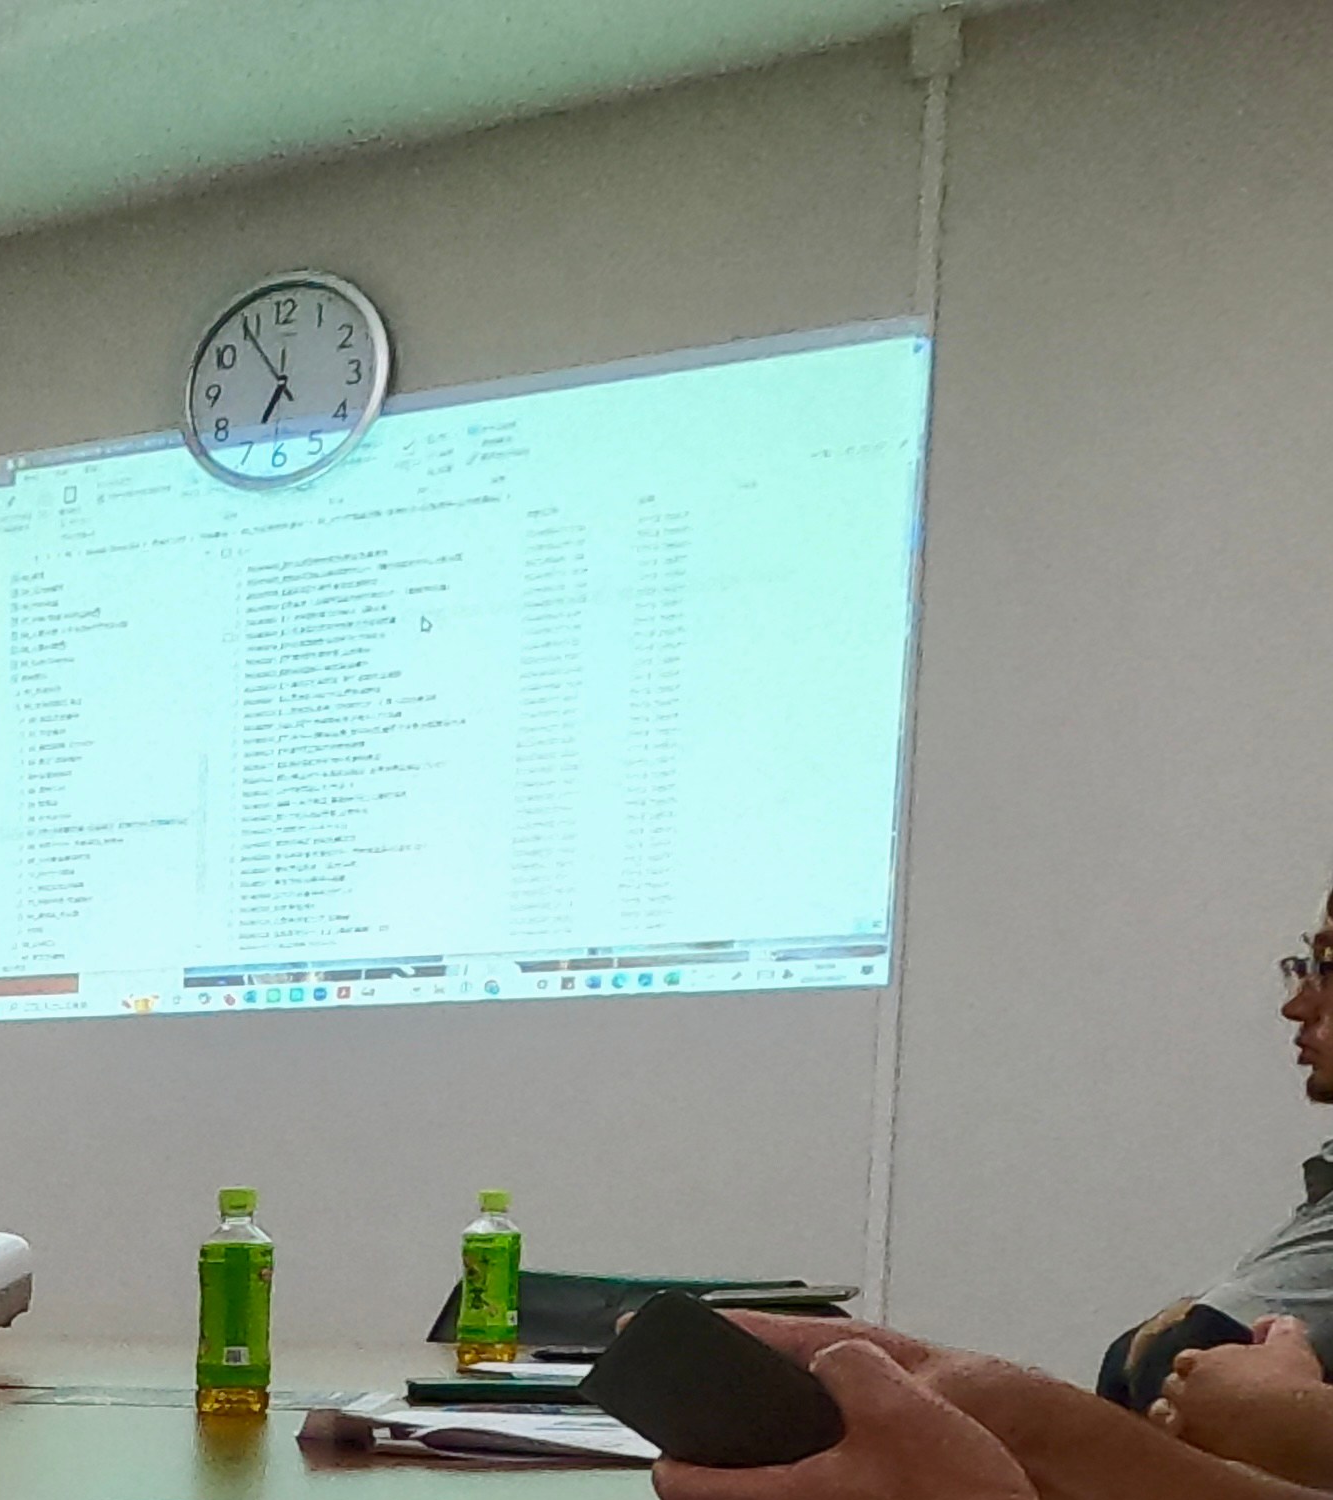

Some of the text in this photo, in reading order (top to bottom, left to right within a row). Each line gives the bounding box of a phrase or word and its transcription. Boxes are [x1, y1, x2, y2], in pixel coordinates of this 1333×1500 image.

[273, 299, 297, 325] 12
[315, 303, 323, 328] 1
[242, 313, 261, 340] 11
[337, 324, 354, 351] 2
[216, 345, 237, 370] 10
[345, 359, 362, 385] 3
[204, 384, 222, 408] 9
[331, 399, 348, 422] 4
[214, 418, 230, 442] 8
[307, 430, 323, 455] 5
[239, 440, 254, 465] 7
[271, 443, 287, 468] 6
